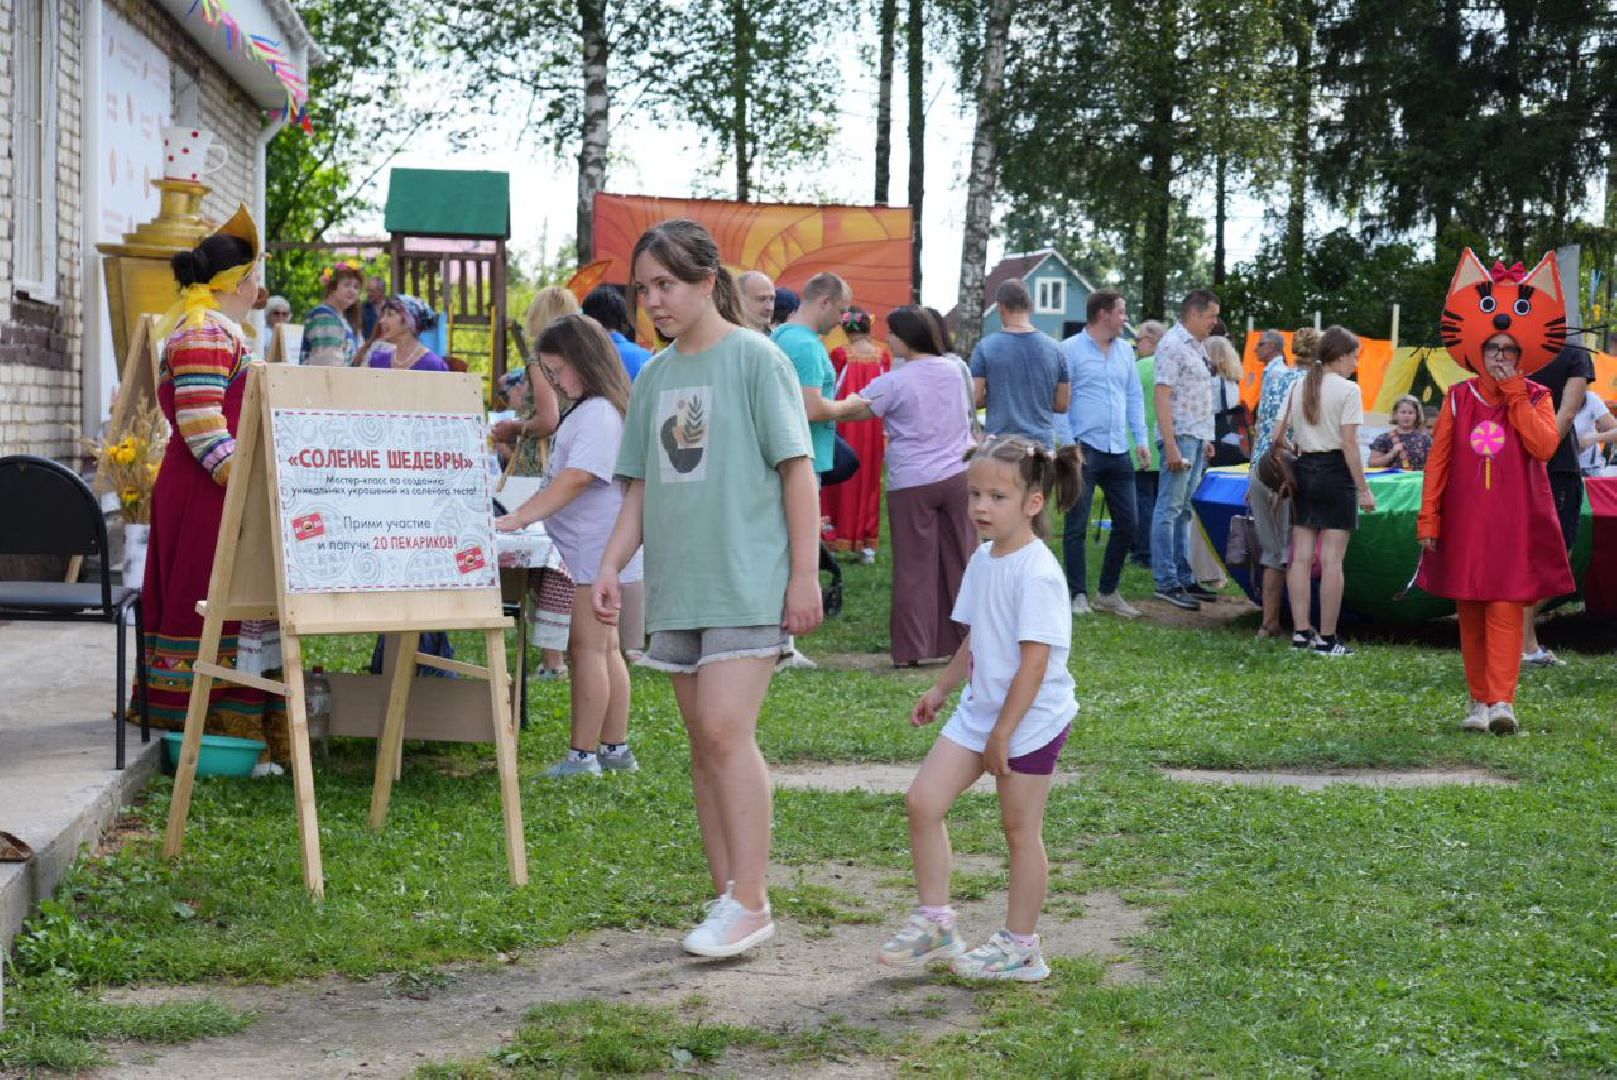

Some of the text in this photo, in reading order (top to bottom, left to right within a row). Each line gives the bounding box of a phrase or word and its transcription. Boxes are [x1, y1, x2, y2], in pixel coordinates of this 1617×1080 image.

[288, 449, 473, 470] «СОЛЕНЫЕ ШЕДЕВРЫ»
[348, 487, 397, 497] украшений
[343, 516, 431, 533] Прими участие
[329, 541, 369, 552] получи
[372, 536, 388, 549] 20
[391, 536, 458, 549] ПЕКАРИКОВ!
